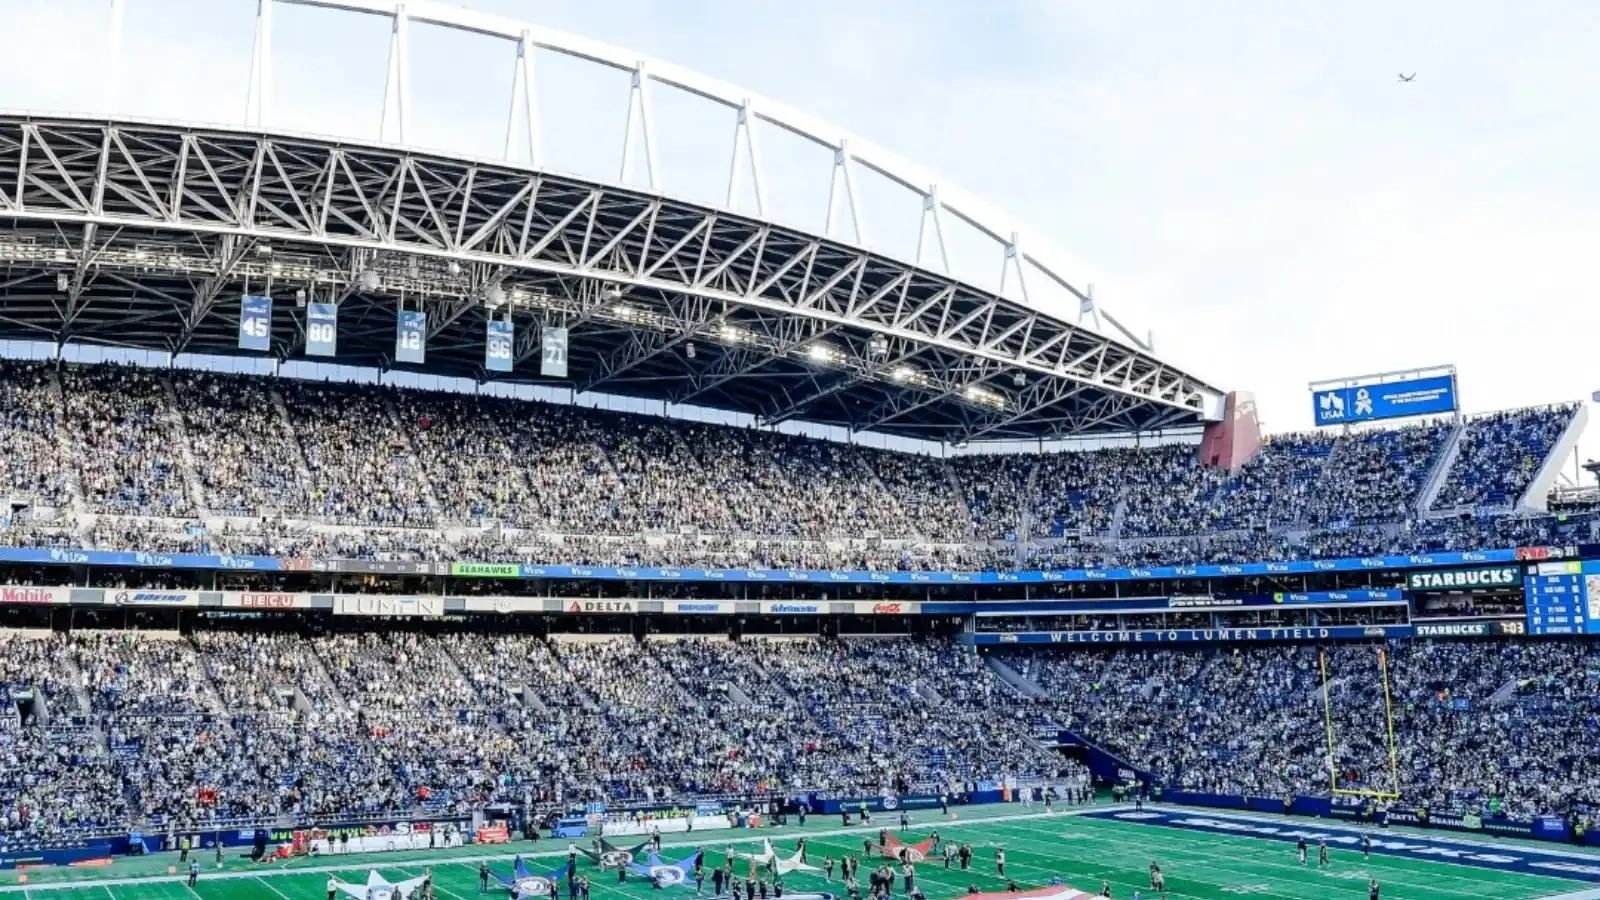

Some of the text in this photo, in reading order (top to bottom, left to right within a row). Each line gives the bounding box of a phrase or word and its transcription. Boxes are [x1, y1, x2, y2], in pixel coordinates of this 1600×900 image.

[243, 317, 268, 337] 45
[310, 323, 334, 343] 80
[401, 331, 420, 350] 12
[489, 341, 511, 359] 96
[546, 346, 563, 364] 71
[1320, 409, 1344, 420] USAA
[459, 566, 513, 574] SEAHAWKS
[1411, 569, 1513, 587] STARBUCKS
[2, 589, 52, 601] Mobile
[133, 593, 187, 602] BOEING
[243, 595, 292, 606] BECU
[585, 602, 632, 611] DELTA
[1417, 625, 1484, 635] STARBUCKS
[1501, 622, 1523, 633] 7:03
[1051, 629, 1328, 642] WELCOME TO LUMEN FIELD
